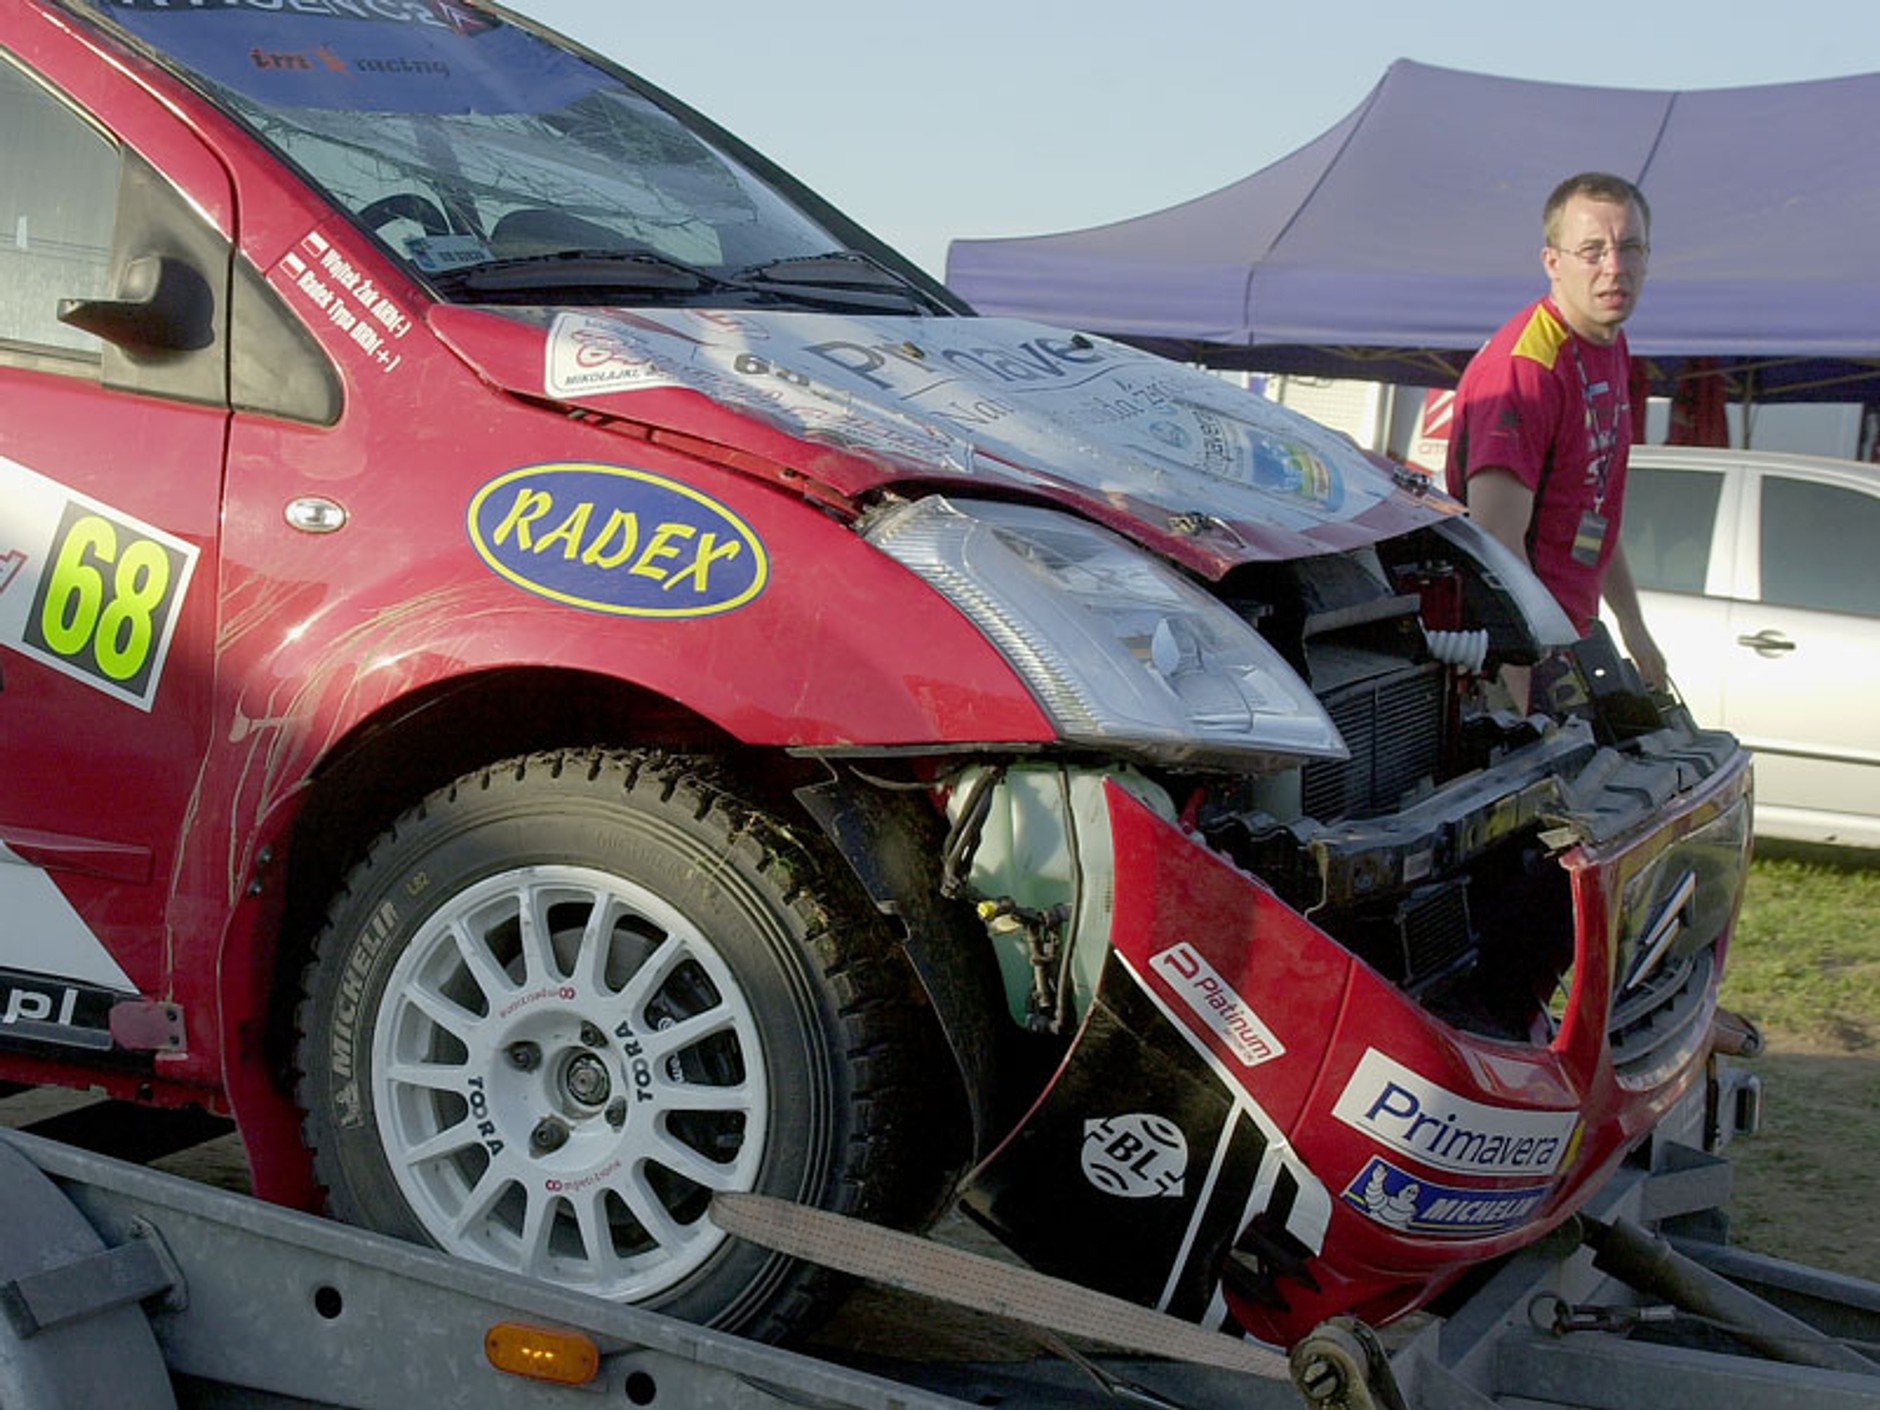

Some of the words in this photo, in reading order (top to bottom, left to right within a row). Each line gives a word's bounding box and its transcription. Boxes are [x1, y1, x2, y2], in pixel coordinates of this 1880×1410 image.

[492, 488, 741, 592] RADEX
[42, 516, 169, 680] 68
[331, 900, 398, 1080] MICHELIN
[1193, 976, 1273, 1060] Platinum
[614, 1019, 654, 1103] TOORA
[467, 1076, 505, 1156] TOORA
[1103, 1130, 1160, 1182] BL
[1364, 1080, 1559, 1168] Primavera
[1420, 1196, 1542, 1224] MICHELIN
